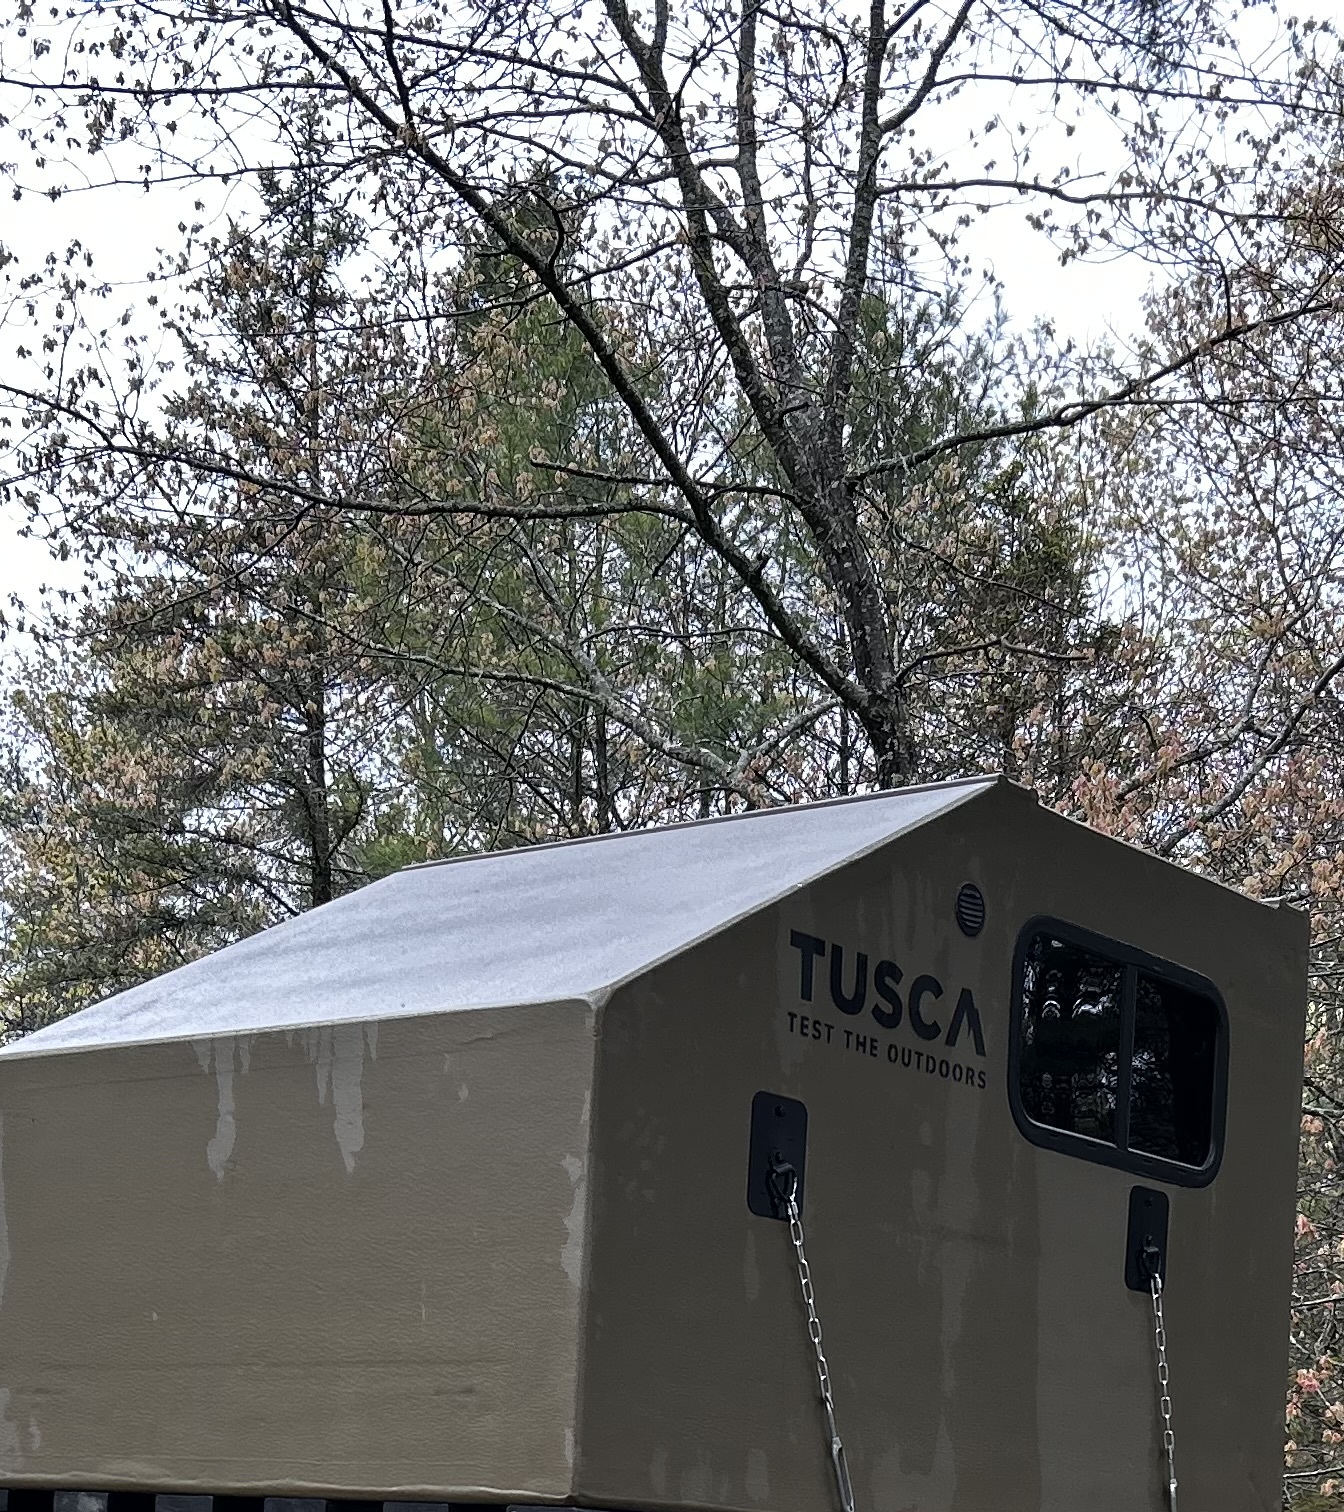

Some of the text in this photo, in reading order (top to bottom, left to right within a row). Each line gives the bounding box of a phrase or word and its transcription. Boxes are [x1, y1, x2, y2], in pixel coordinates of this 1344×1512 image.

[790, 929, 987, 1057] TUSCA
[787, 1011, 987, 1090] TEST THE OUTDOORS
